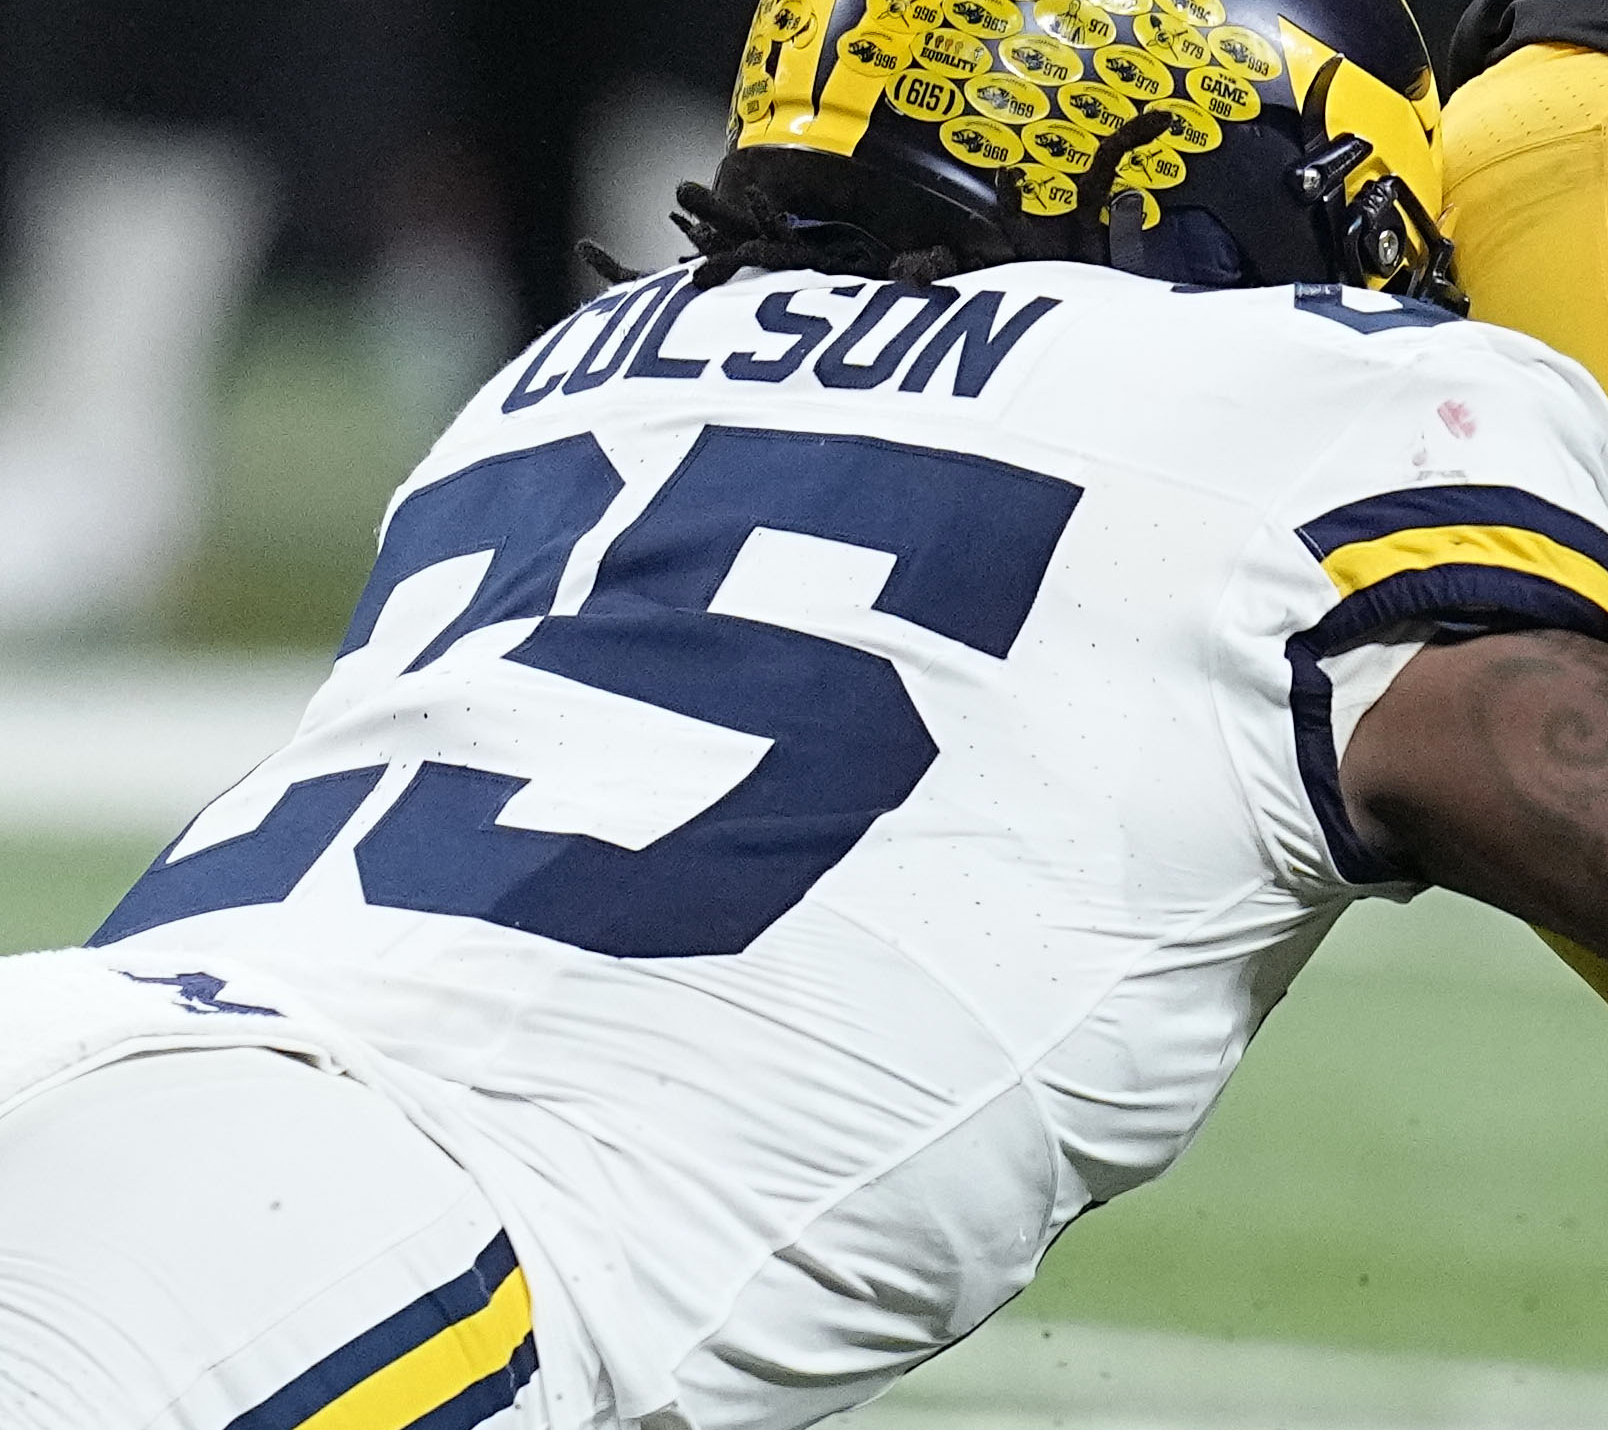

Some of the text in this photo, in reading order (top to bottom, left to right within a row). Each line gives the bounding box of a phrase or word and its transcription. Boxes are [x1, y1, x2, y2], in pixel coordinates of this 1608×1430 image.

[911, 4, 936, 23] 996
[1089, 18, 1110, 38] 971
[919, 46, 979, 74] EQUALITY
[1181, 39, 1204, 60] 979
[874, 51, 898, 71] 996
[1043, 61, 1069, 82] 970
[1135, 74, 1160, 95] 979
[1200, 75, 1249, 107] GAME
[1009, 98, 1035, 119] 969
[1208, 97, 1233, 117] 988
[1184, 126, 1209, 147] 985
[982, 143, 1008, 163] 968
[1066, 148, 1091, 169] 977
[1155, 159, 1180, 180] 983
[1048, 186, 1074, 206] 972
[502, 263, 1062, 415] COLSON
[86, 423, 1084, 959] 25
